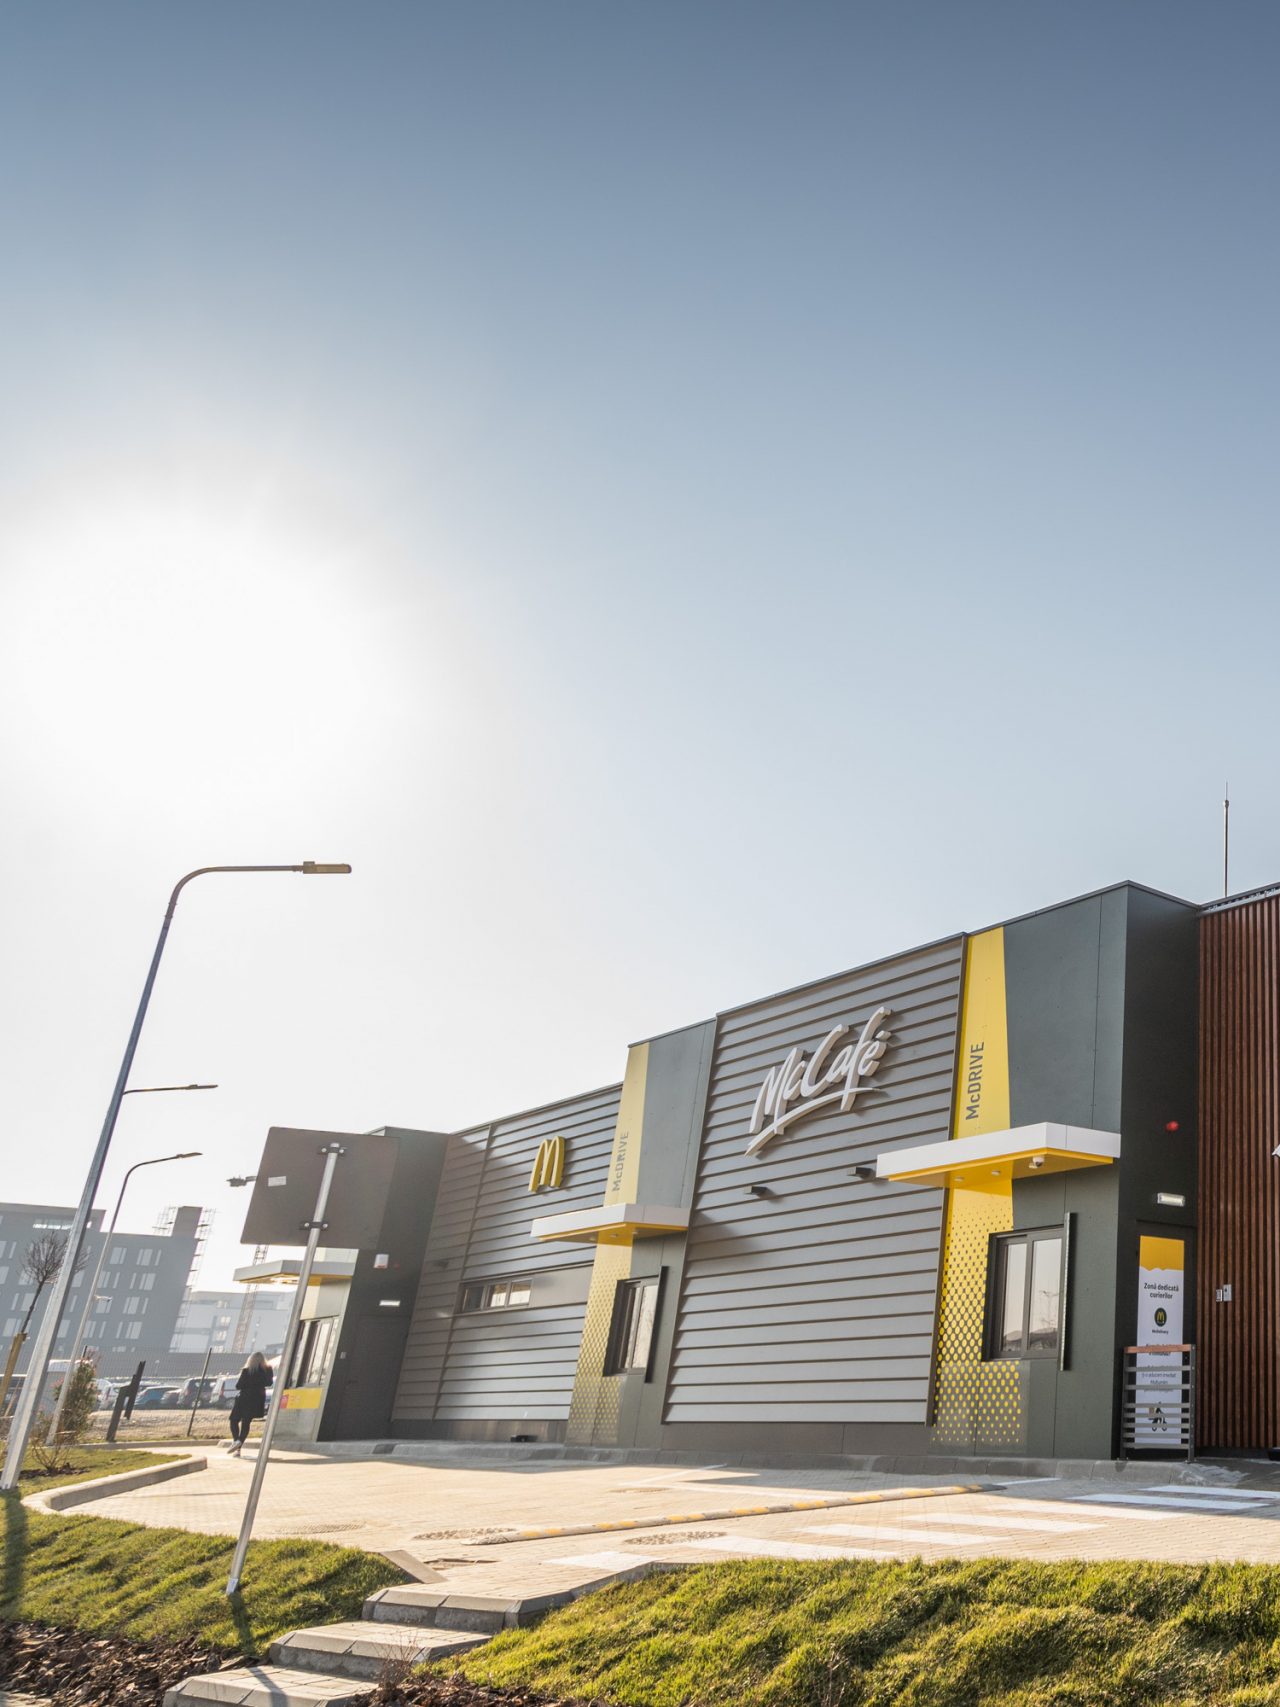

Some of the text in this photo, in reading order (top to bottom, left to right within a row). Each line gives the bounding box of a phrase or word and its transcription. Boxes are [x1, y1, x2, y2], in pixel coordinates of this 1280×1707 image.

[748, 1007, 892, 1135] McCafé
[965, 1041, 985, 1120] McDRIVE
[612, 1132, 630, 1192] McDRIVE
